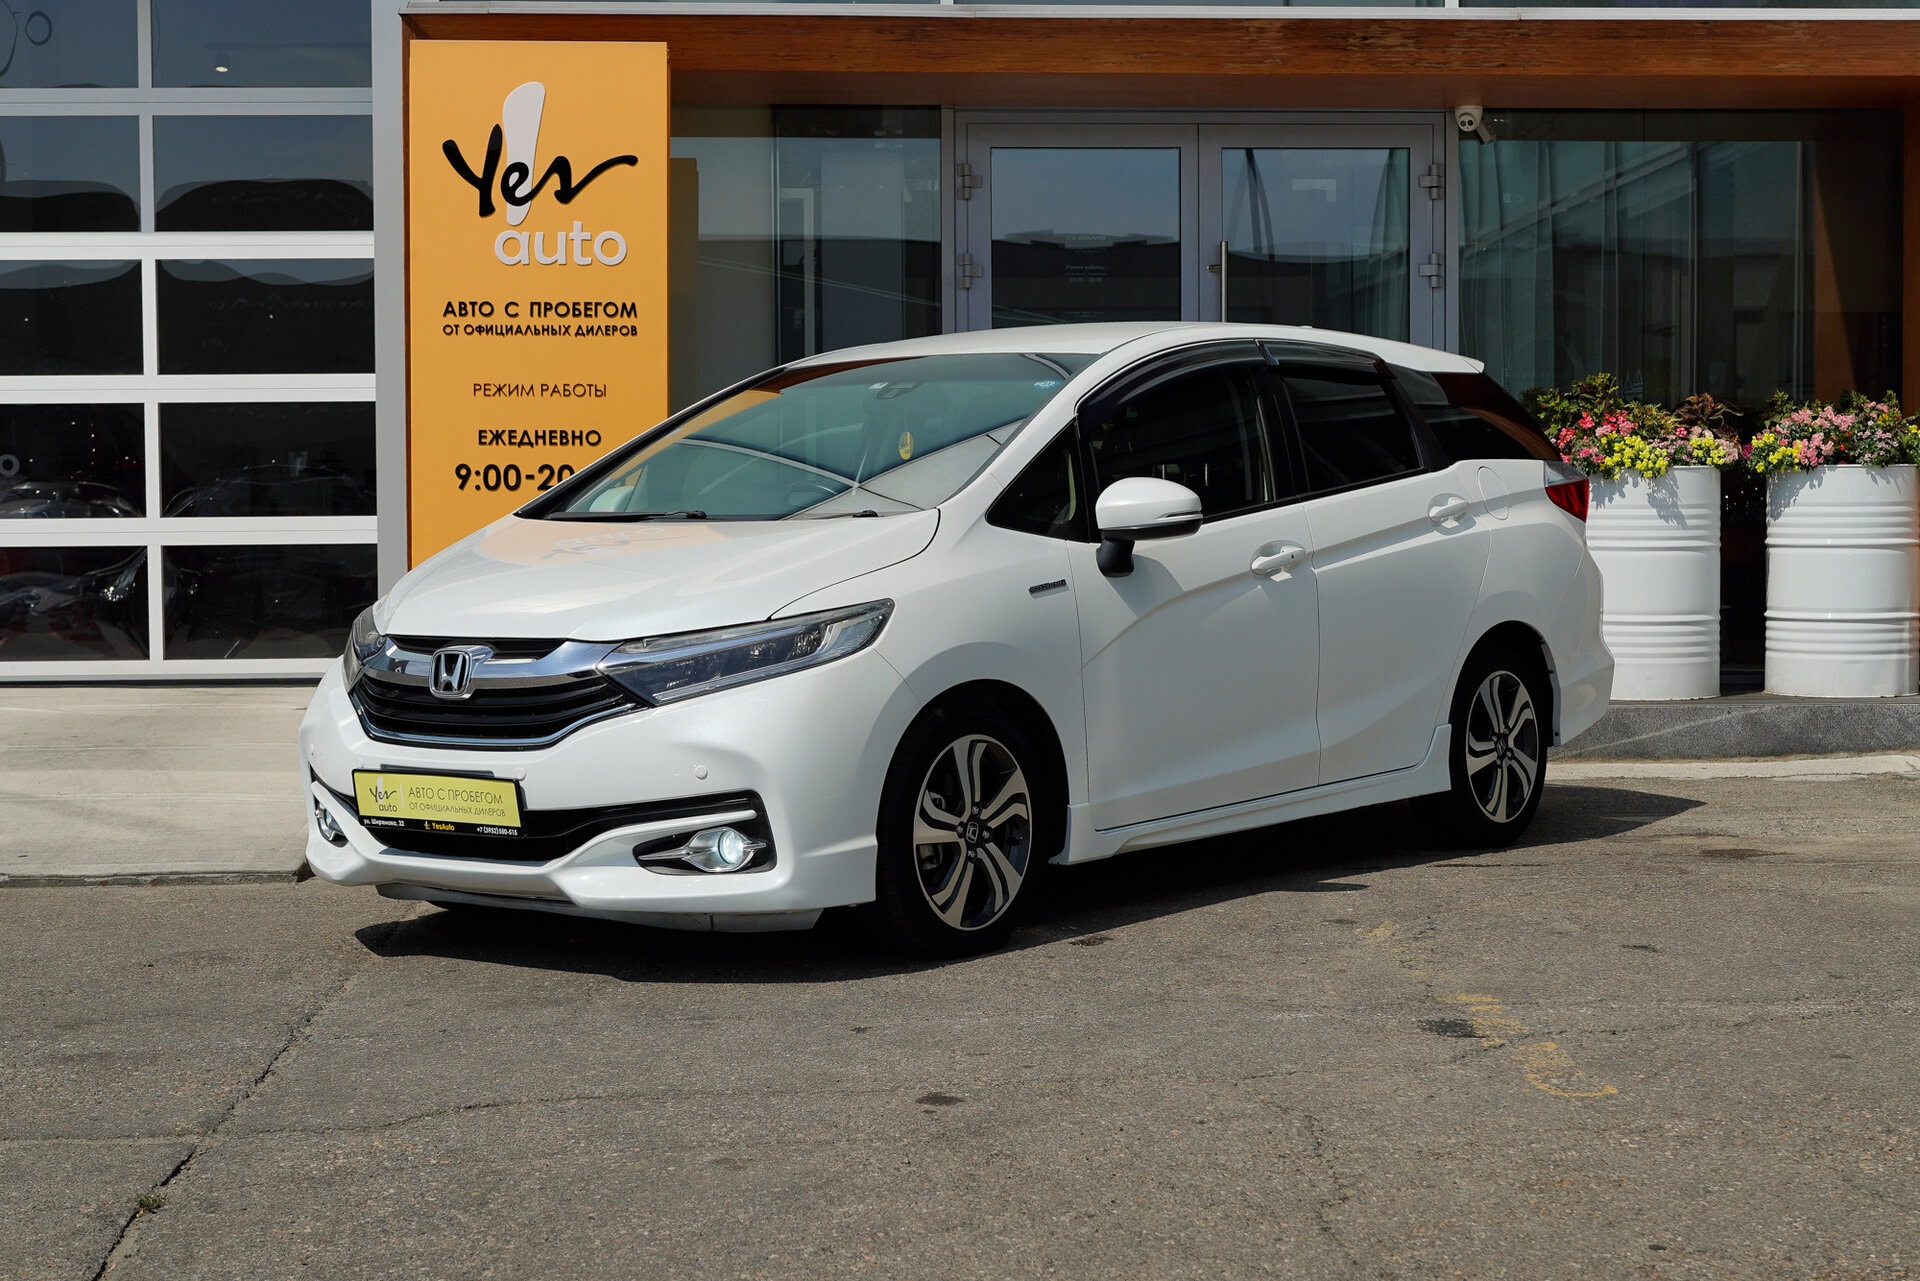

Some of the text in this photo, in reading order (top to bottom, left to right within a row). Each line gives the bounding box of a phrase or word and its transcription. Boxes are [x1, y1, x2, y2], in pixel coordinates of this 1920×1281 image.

[442, 123, 639, 218] Yes
[494, 220, 628, 266] auto
[442, 300, 638, 319] АВТО С ПРОБЕГОМ
[442, 323, 638, 338] ОТ ОФИЦИАЛЬНЫХ ДИЛЕРОВ
[473, 383, 607, 398] РЕЖИМ РАБОТЫ
[478, 429, 602, 448] ЕЖЕДНЕВНО
[408, 786, 503, 805] АВТО С ПРОБЕГОМ
[378, 803, 398, 813] auto
[408, 802, 506, 817] ОТ ОФИЦИАЛЬНЫХ ДИЛЕРОВ
[431, 822, 455, 831] YesAuto
